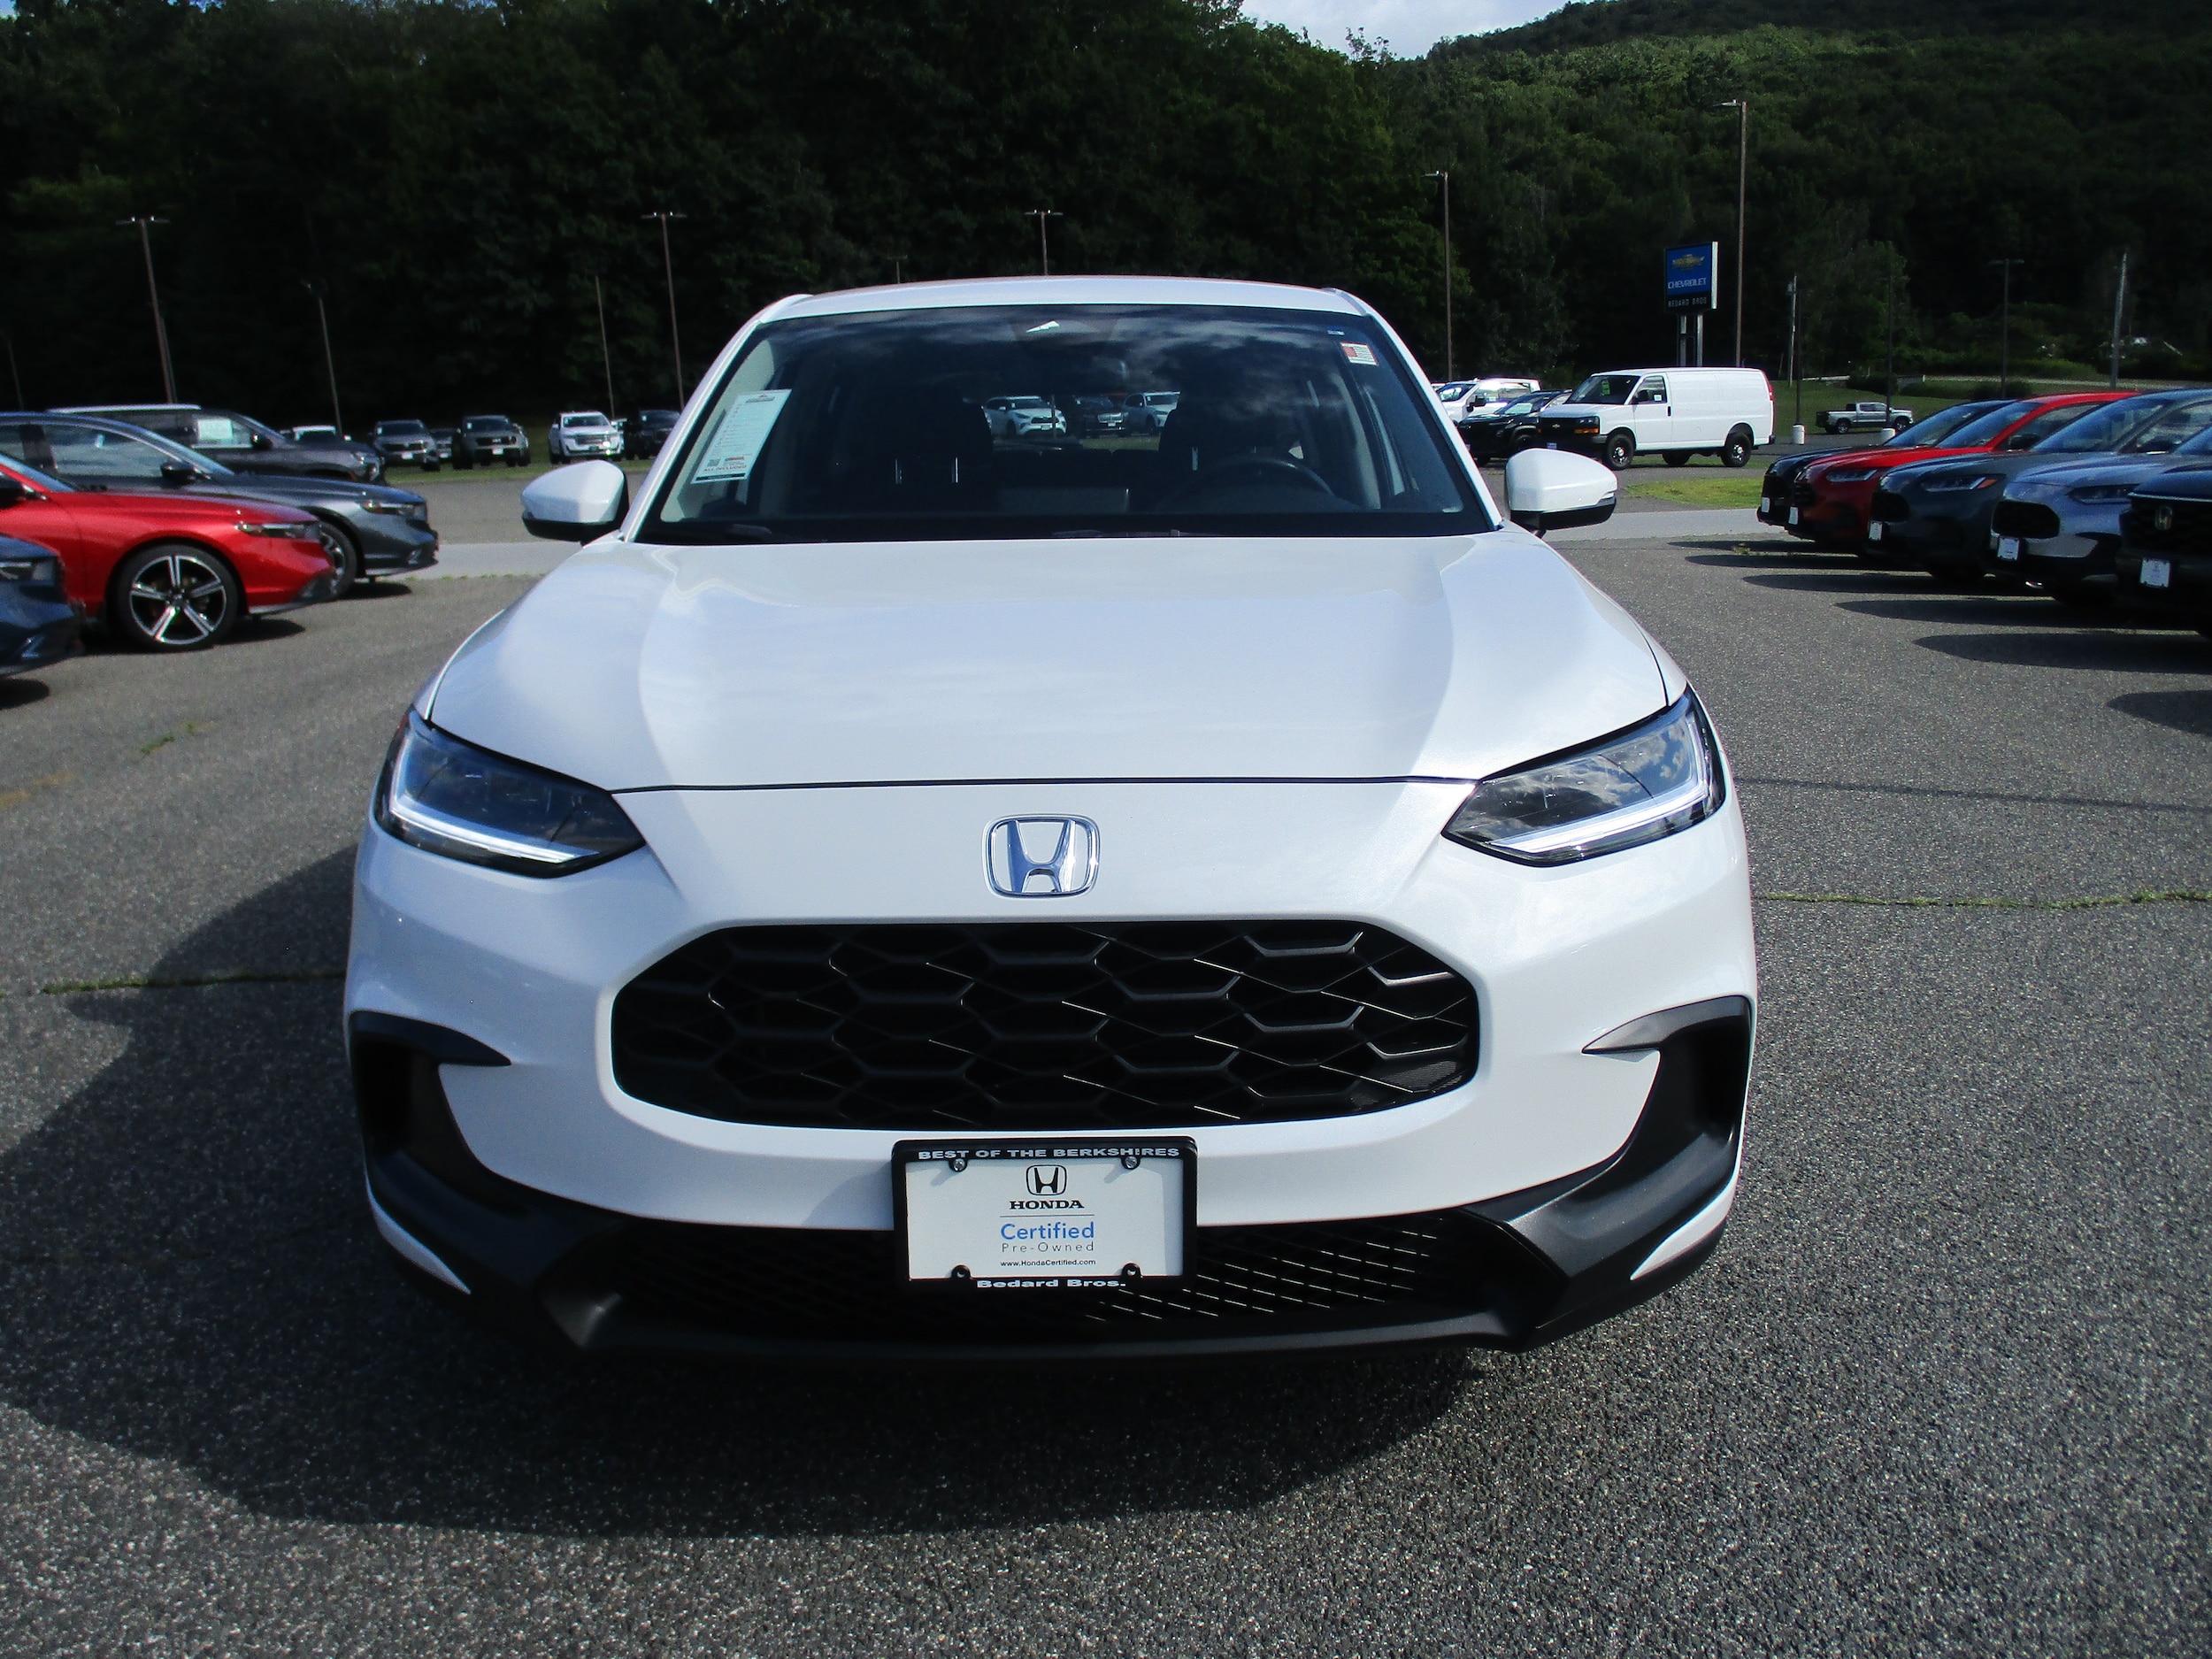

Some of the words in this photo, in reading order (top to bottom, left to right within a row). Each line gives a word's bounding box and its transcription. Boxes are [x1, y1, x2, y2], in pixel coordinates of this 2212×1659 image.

[1668, 277, 1706, 288] CHEVROLET
[918, 1149, 970, 1160] BEST
[975, 1149, 1001, 1158] OF
[1053, 1148, 1180, 1157] BERKSHIRES
[1010, 1200, 1085, 1210] HONDA
[1000, 1221, 1095, 1240] Certified
[1002, 1240, 1094, 1253] Pre-Owned
[977, 1279, 1059, 1288] Bedard
[1066, 1279, 1126, 1287] Bros.
